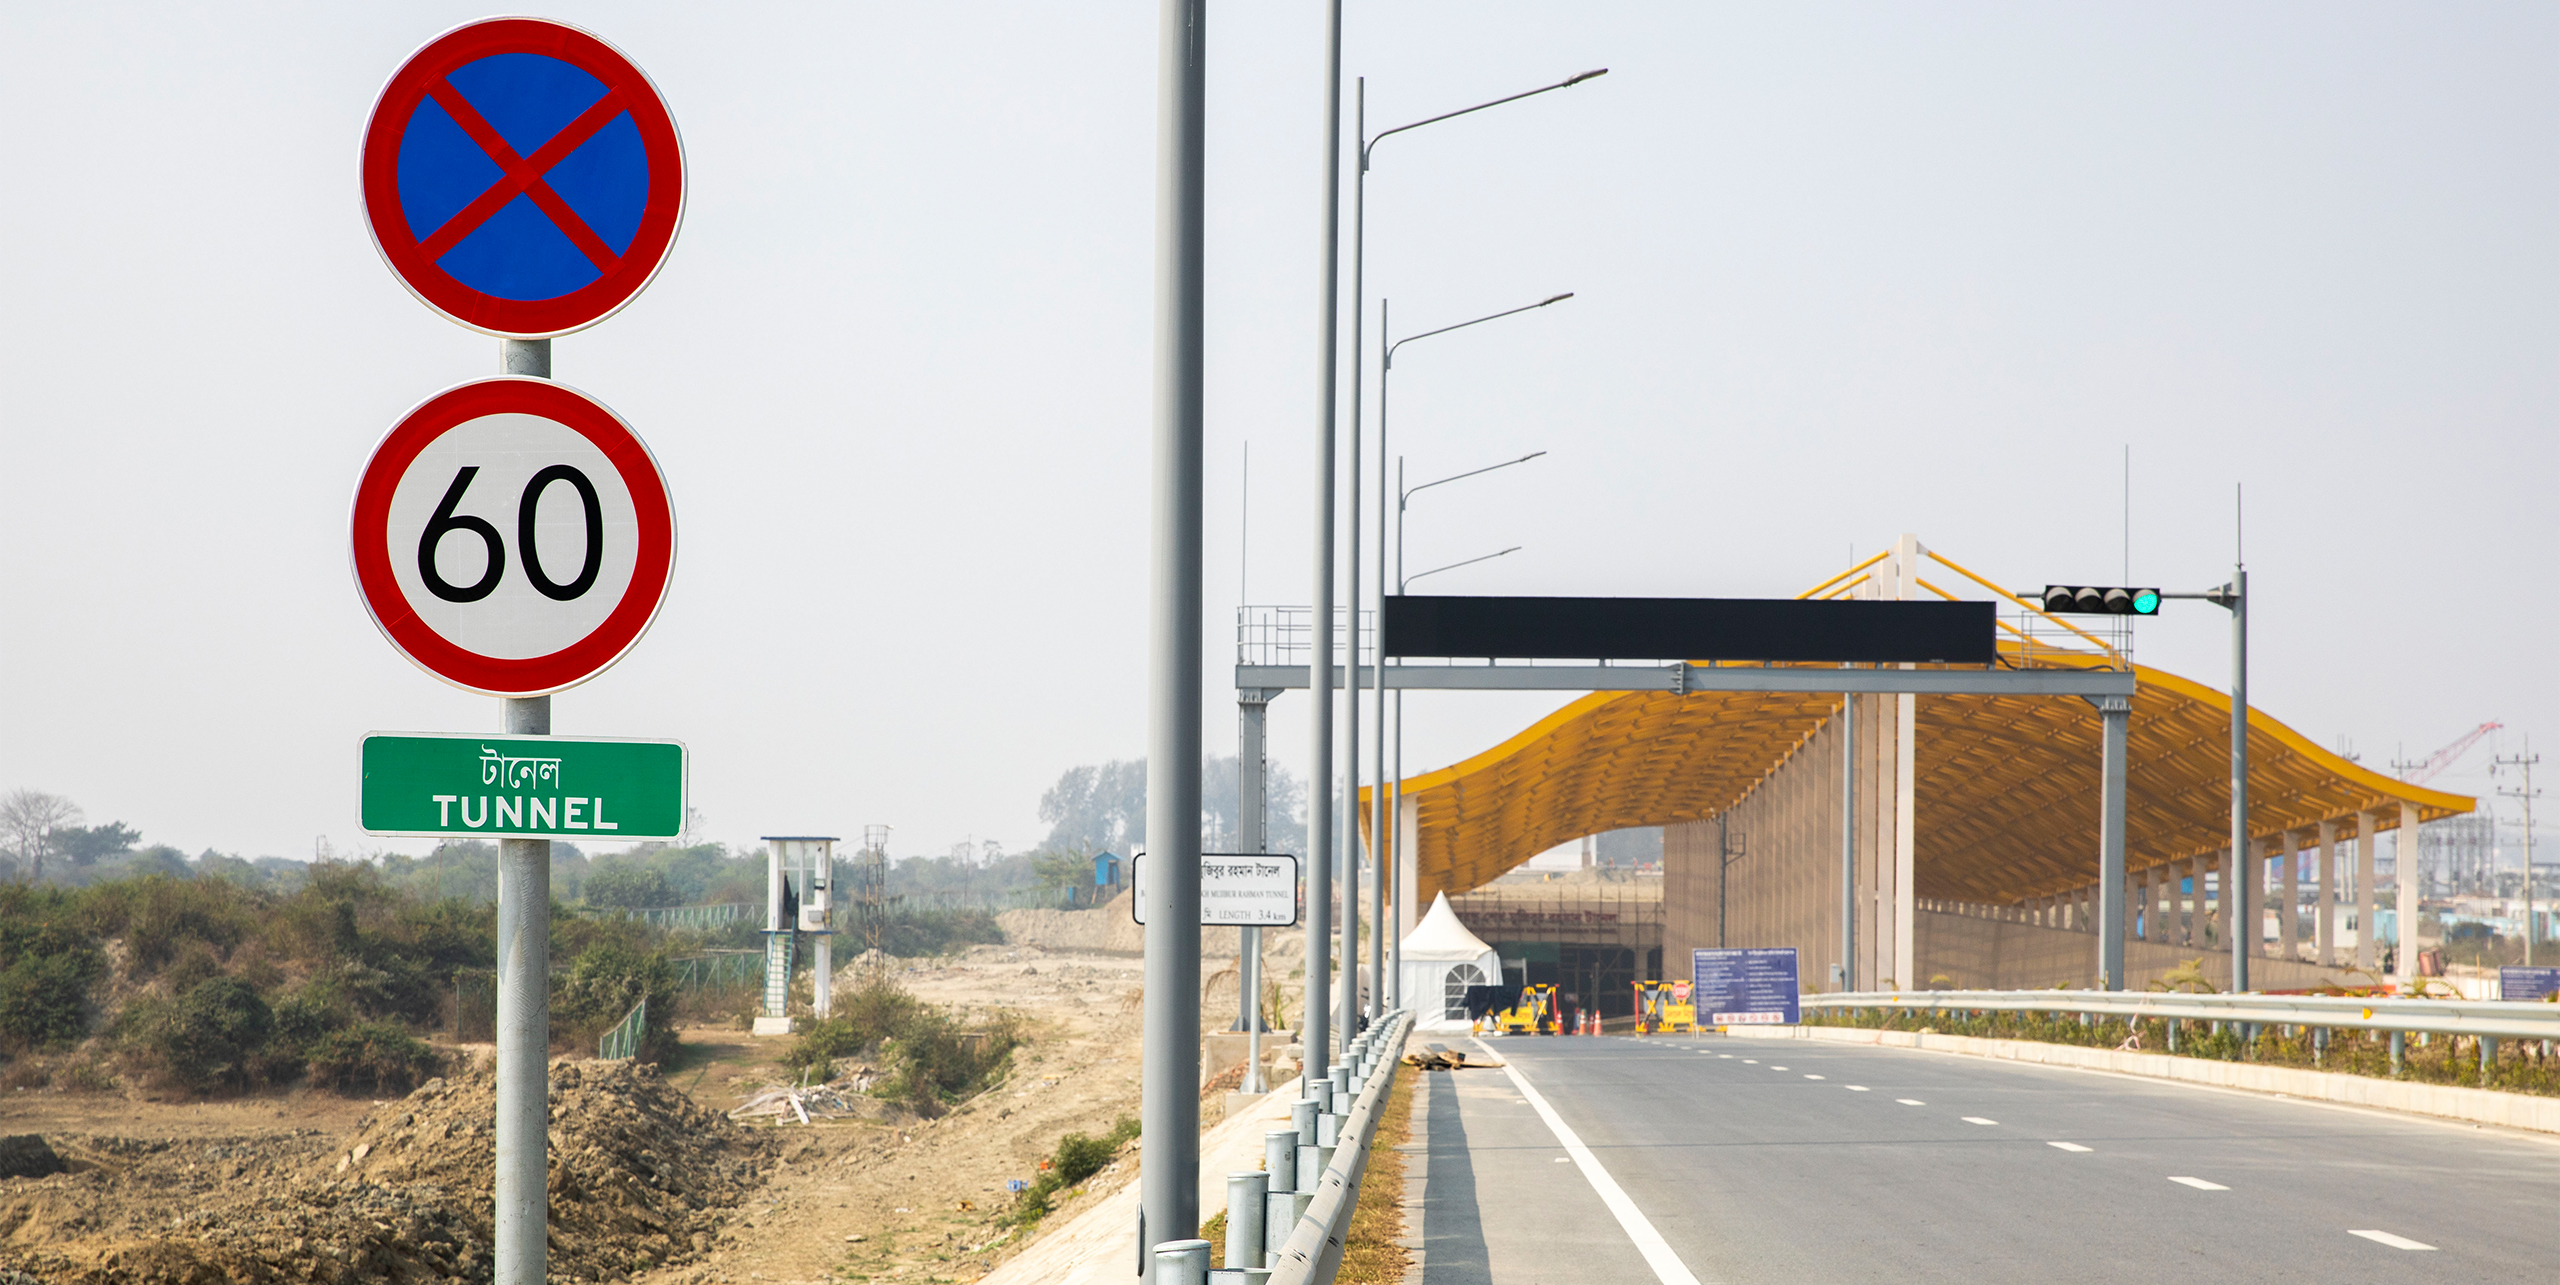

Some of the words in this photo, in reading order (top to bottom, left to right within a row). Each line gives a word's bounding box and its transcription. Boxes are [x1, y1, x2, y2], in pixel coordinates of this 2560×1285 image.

[418, 464, 603, 603] 60
[479, 744, 562, 790] টানেল
[432, 795, 618, 830] TUNNEL
[1255, 862, 1281, 878] টানেল
[1211, 890, 1236, 898] MUJIBUR
[1238, 890, 1264, 898] RAHMAN
[1266, 891, 1289, 899] TUNNEL
[1219, 909, 1251, 920] LENGTH
[1258, 909, 1271, 920] 3.4
[1273, 911, 1286, 921] km
